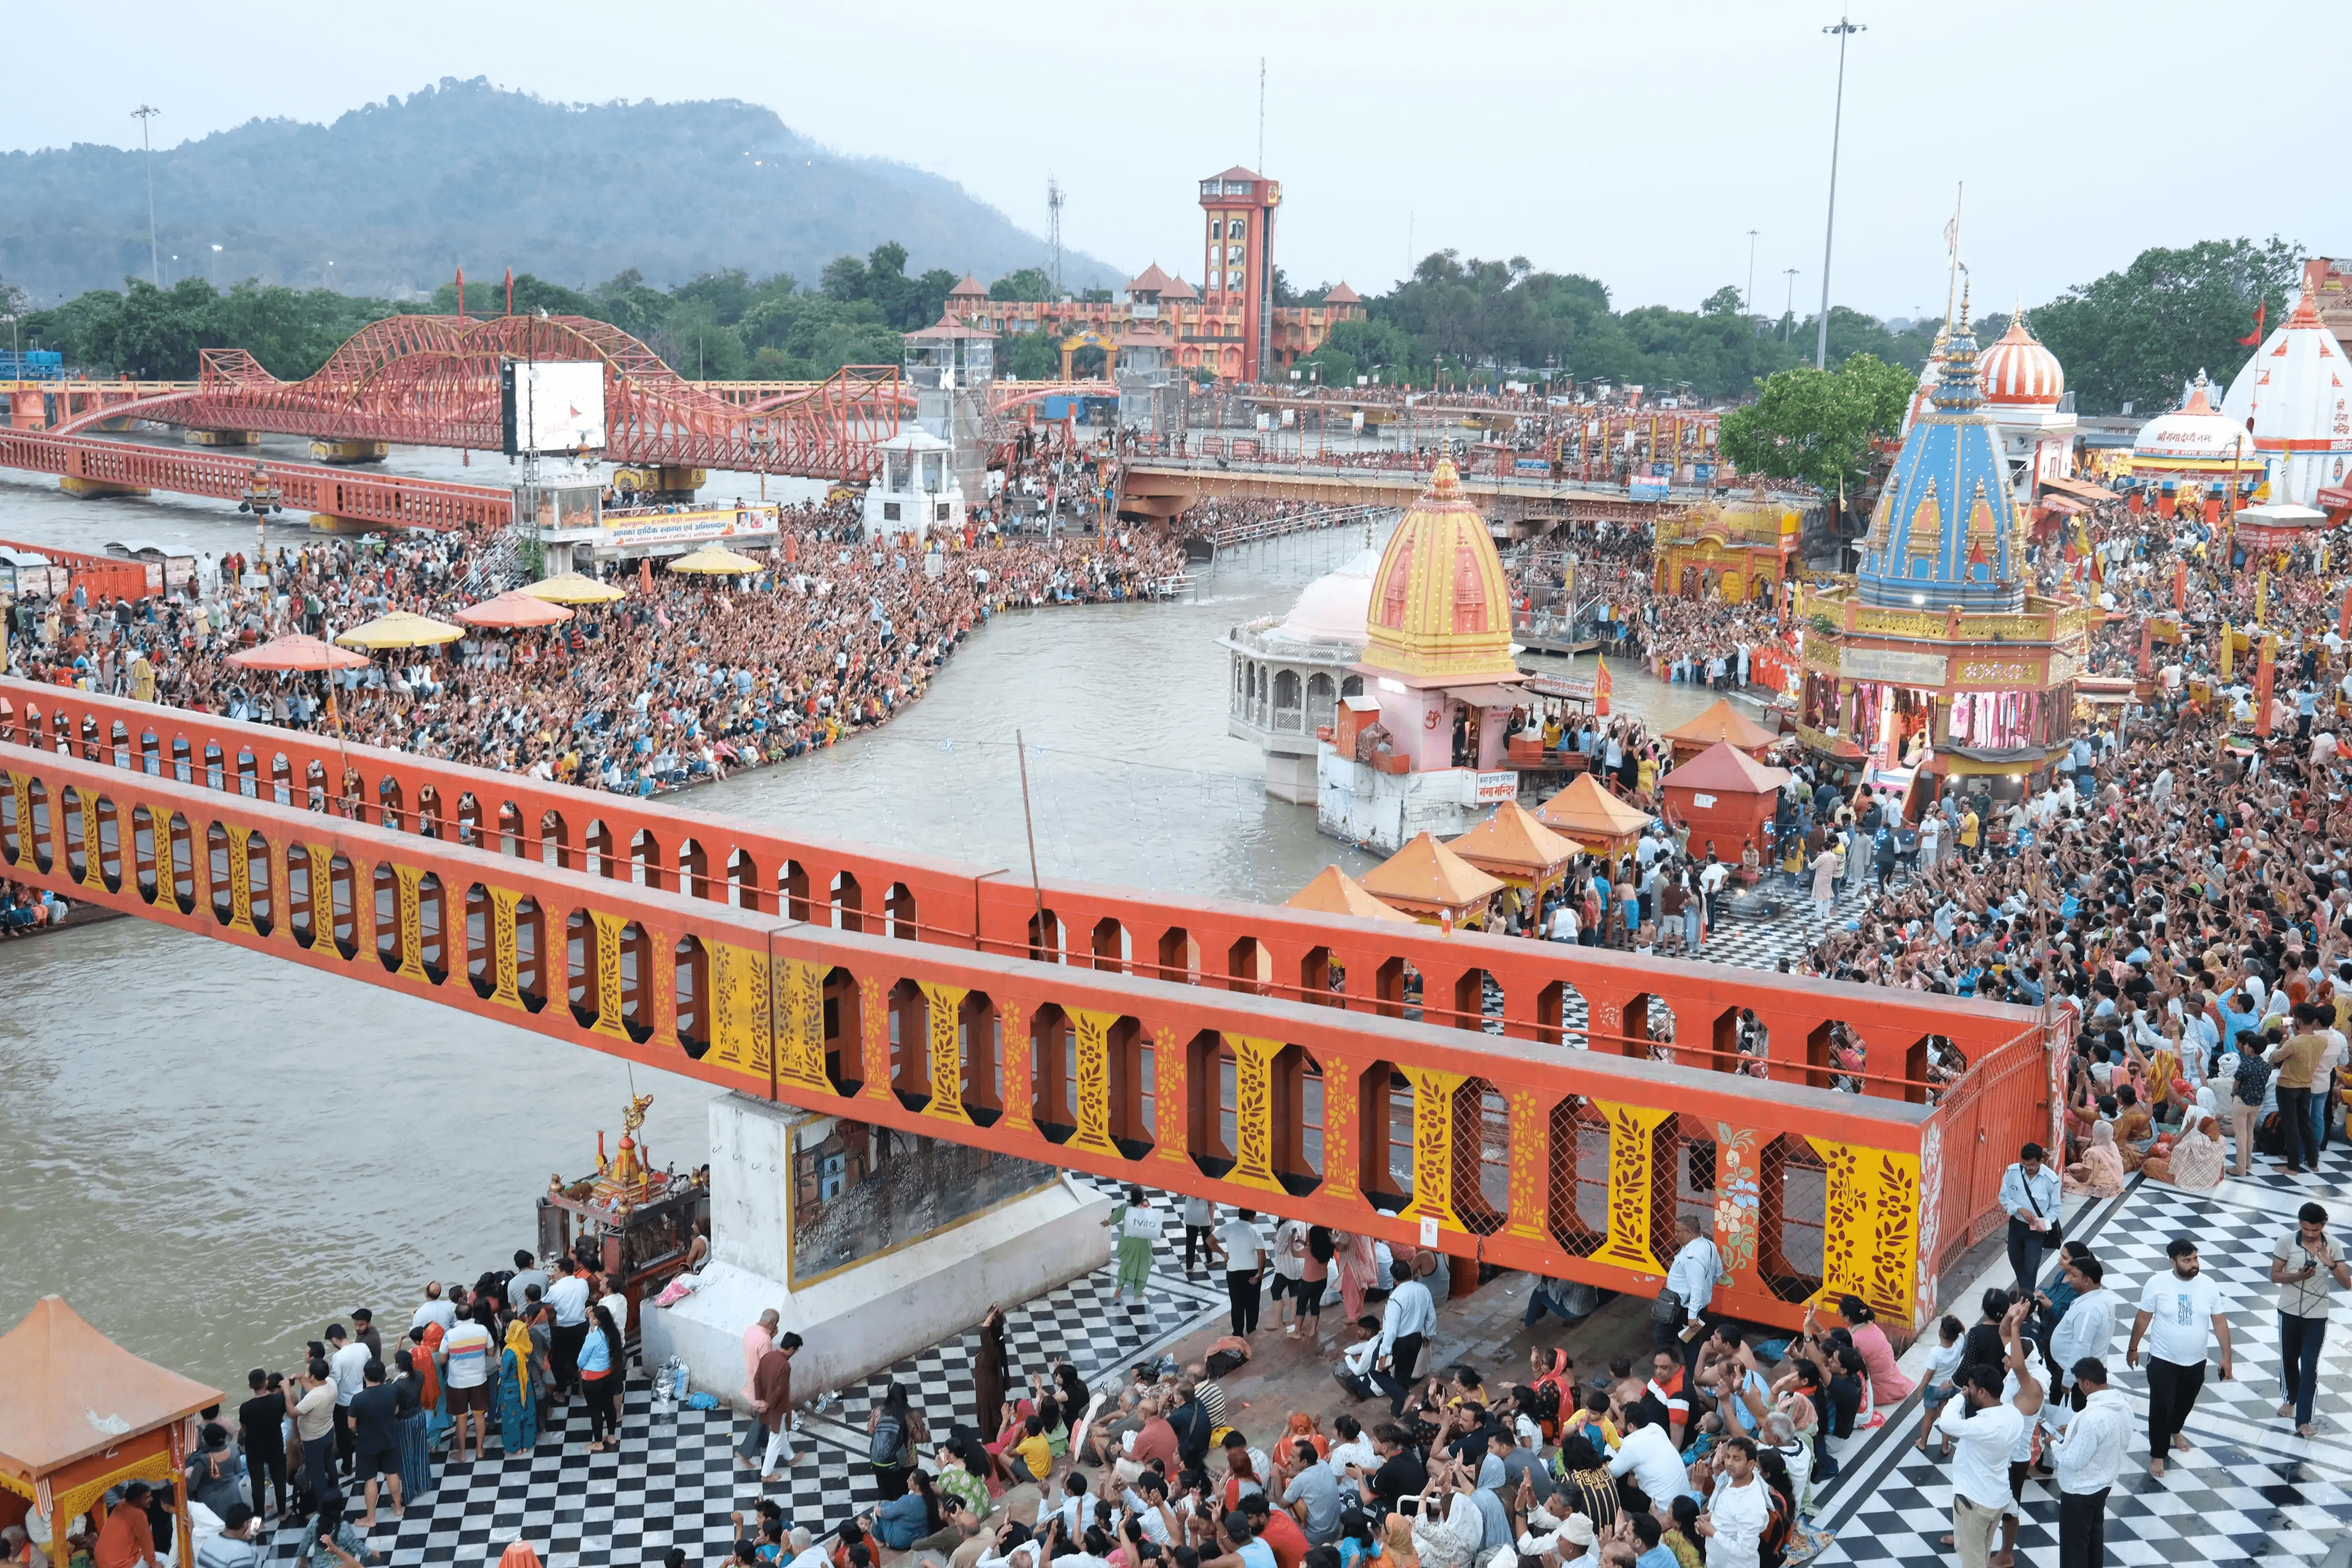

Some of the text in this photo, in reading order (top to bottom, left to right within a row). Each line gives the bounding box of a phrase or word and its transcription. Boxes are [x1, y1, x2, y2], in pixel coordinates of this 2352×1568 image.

[637, 526, 658, 535] हार्दिक
[1479, 783, 1515, 797] गंगा मन्दिर
